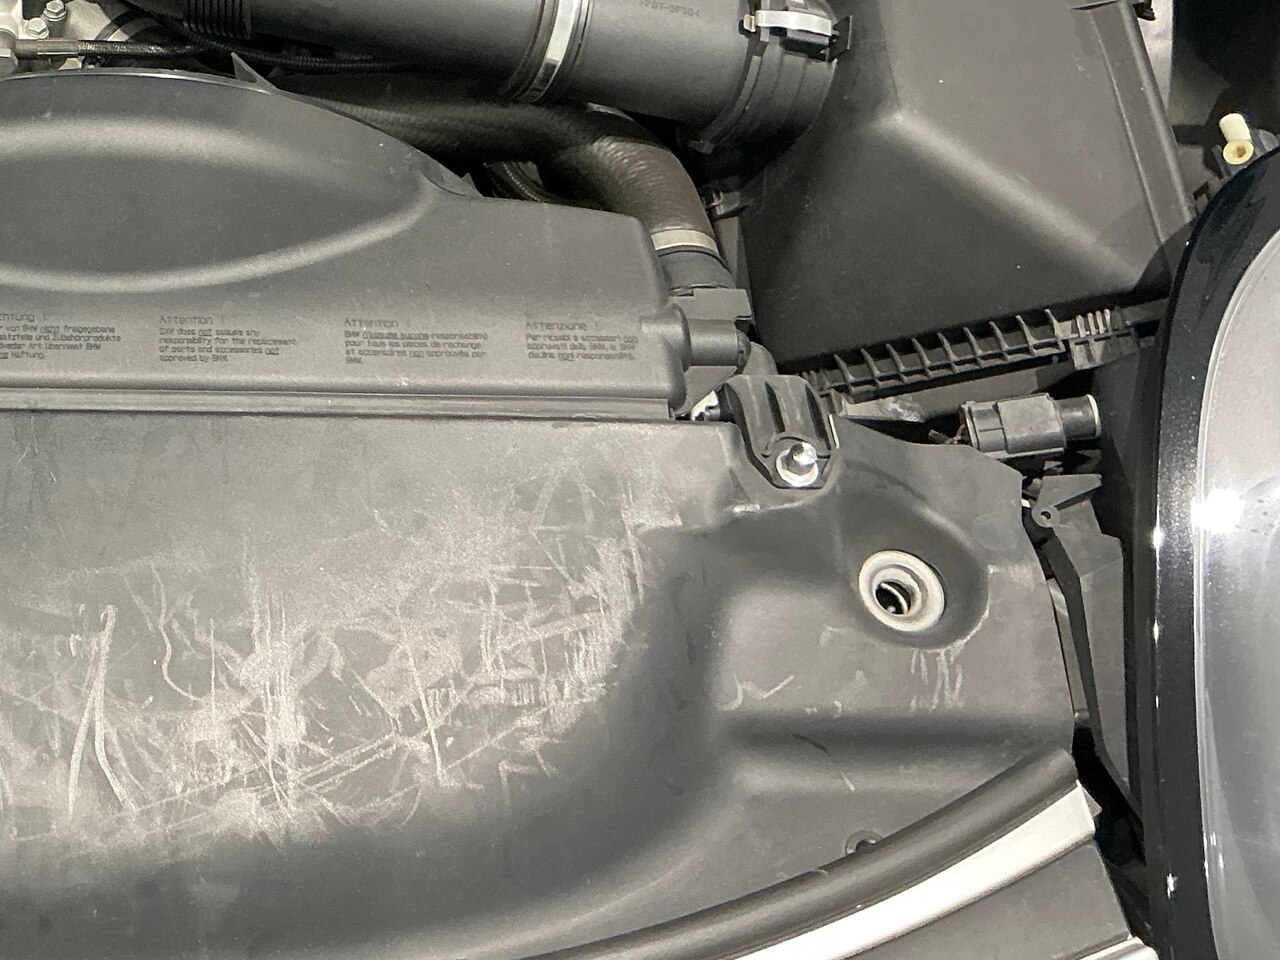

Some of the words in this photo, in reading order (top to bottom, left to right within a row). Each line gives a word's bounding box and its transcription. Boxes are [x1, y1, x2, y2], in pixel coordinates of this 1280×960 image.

[159, 315, 213, 325] Attention
[525, 321, 588, 331] Attenzione
[214, 337, 229, 345] for
[159, 345, 169, 353] of
[199, 354, 210, 363] by
